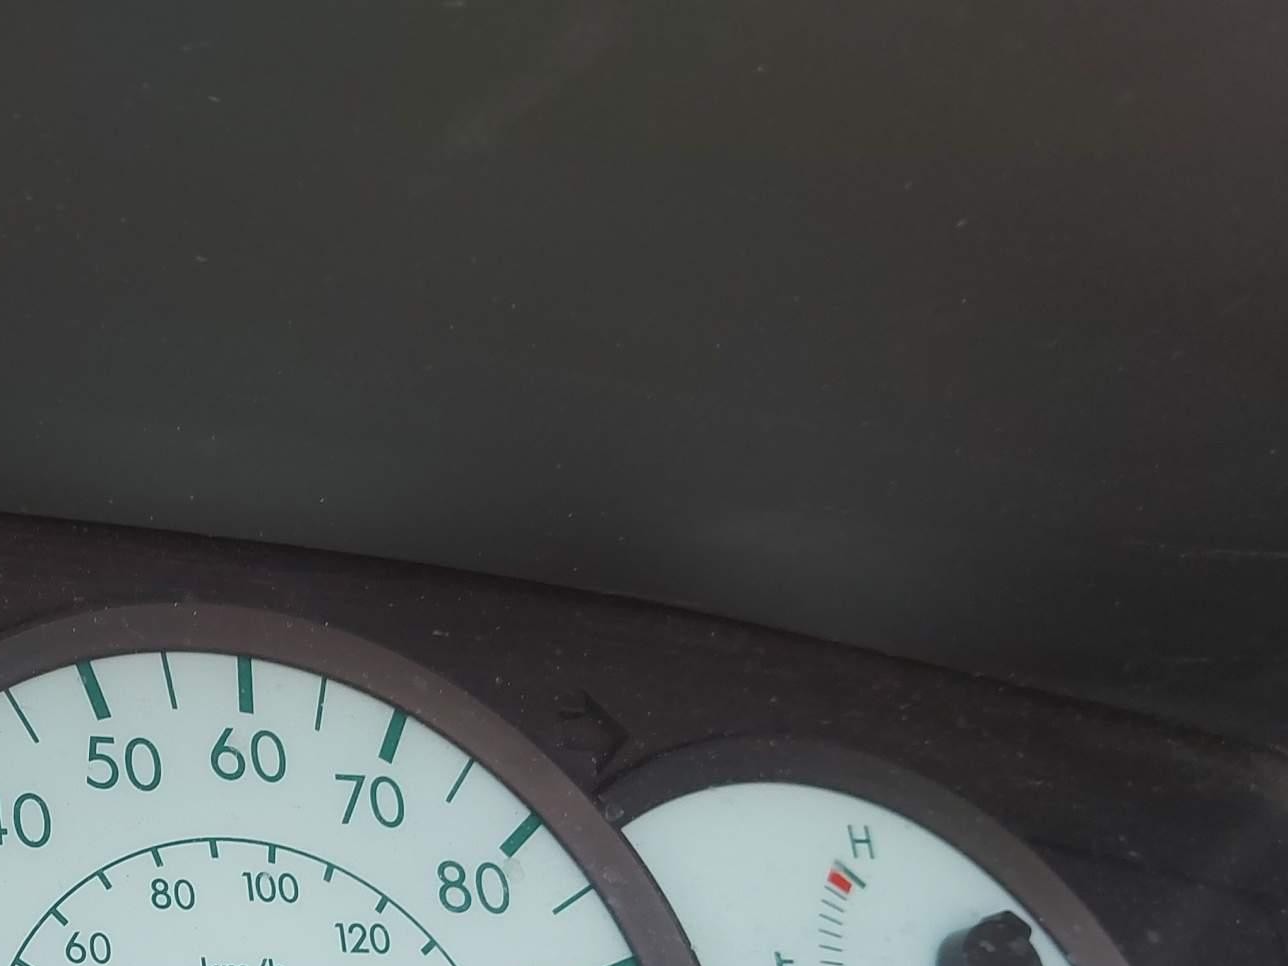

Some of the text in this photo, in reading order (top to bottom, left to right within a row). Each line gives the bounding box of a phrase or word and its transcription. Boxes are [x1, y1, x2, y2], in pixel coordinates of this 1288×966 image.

[87, 736, 161, 791] 50
[211, 728, 286, 782] 60
[335, 774, 404, 828] 70
[848, 825, 874, 859] H
[151, 879, 194, 910] 80
[242, 872, 298, 903] 100
[438, 861, 509, 914] 80
[66, 932, 111, 964] 60
[335, 923, 390, 954] 120
